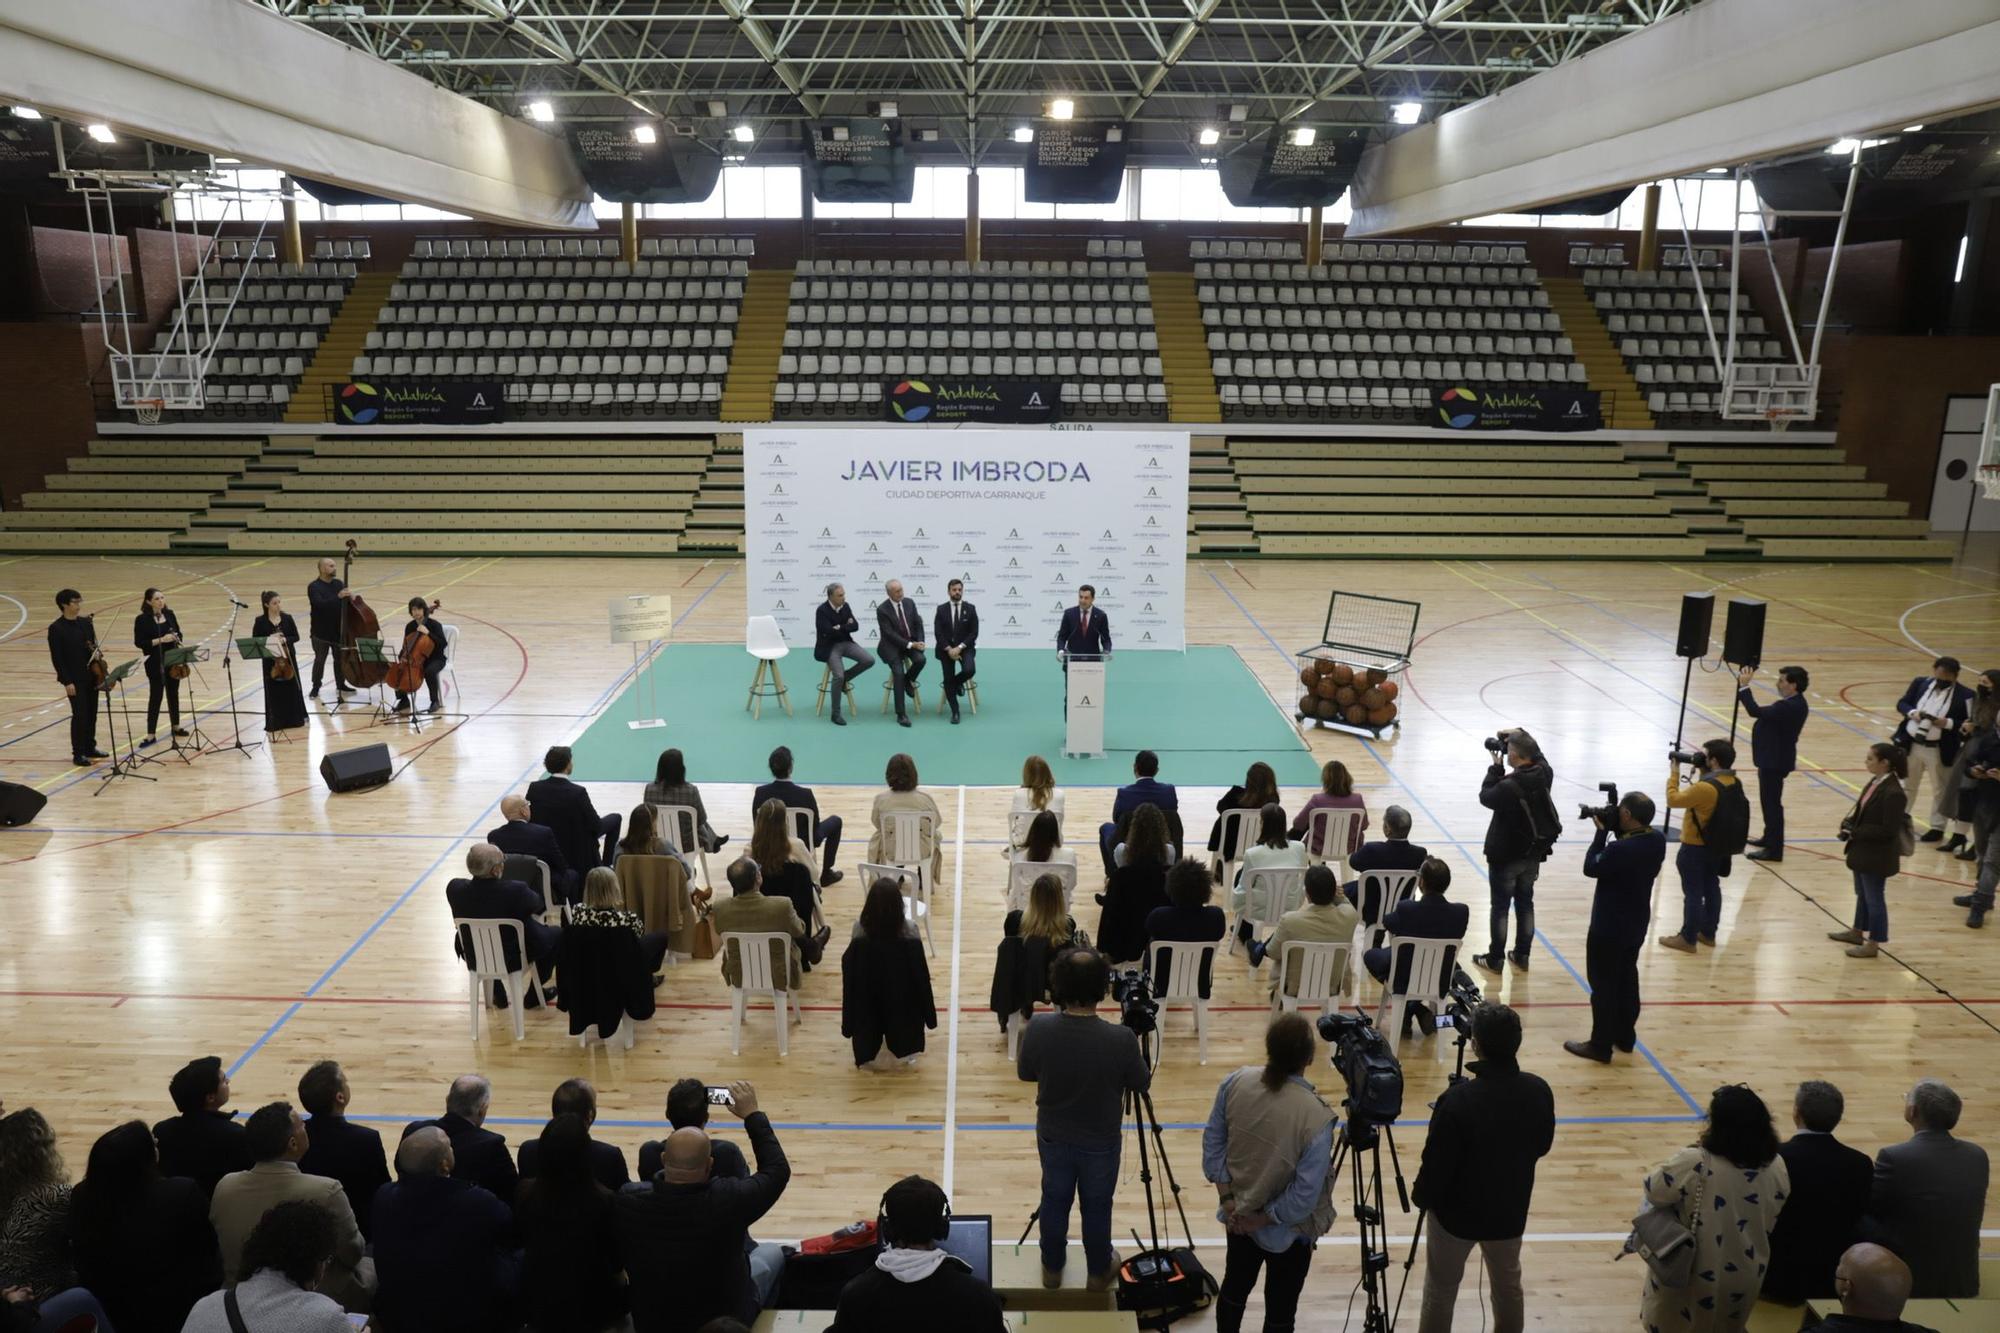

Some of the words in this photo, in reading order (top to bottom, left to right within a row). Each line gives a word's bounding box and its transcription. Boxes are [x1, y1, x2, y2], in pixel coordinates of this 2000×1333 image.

[841, 460, 942, 481] JAVIER
[953, 460, 1091, 482] IMBRODA
[886, 490, 925, 499] CIUDAD
[926, 490, 983, 499] DEPORTIVA
[984, 490, 1046, 501] CARRANQUE
